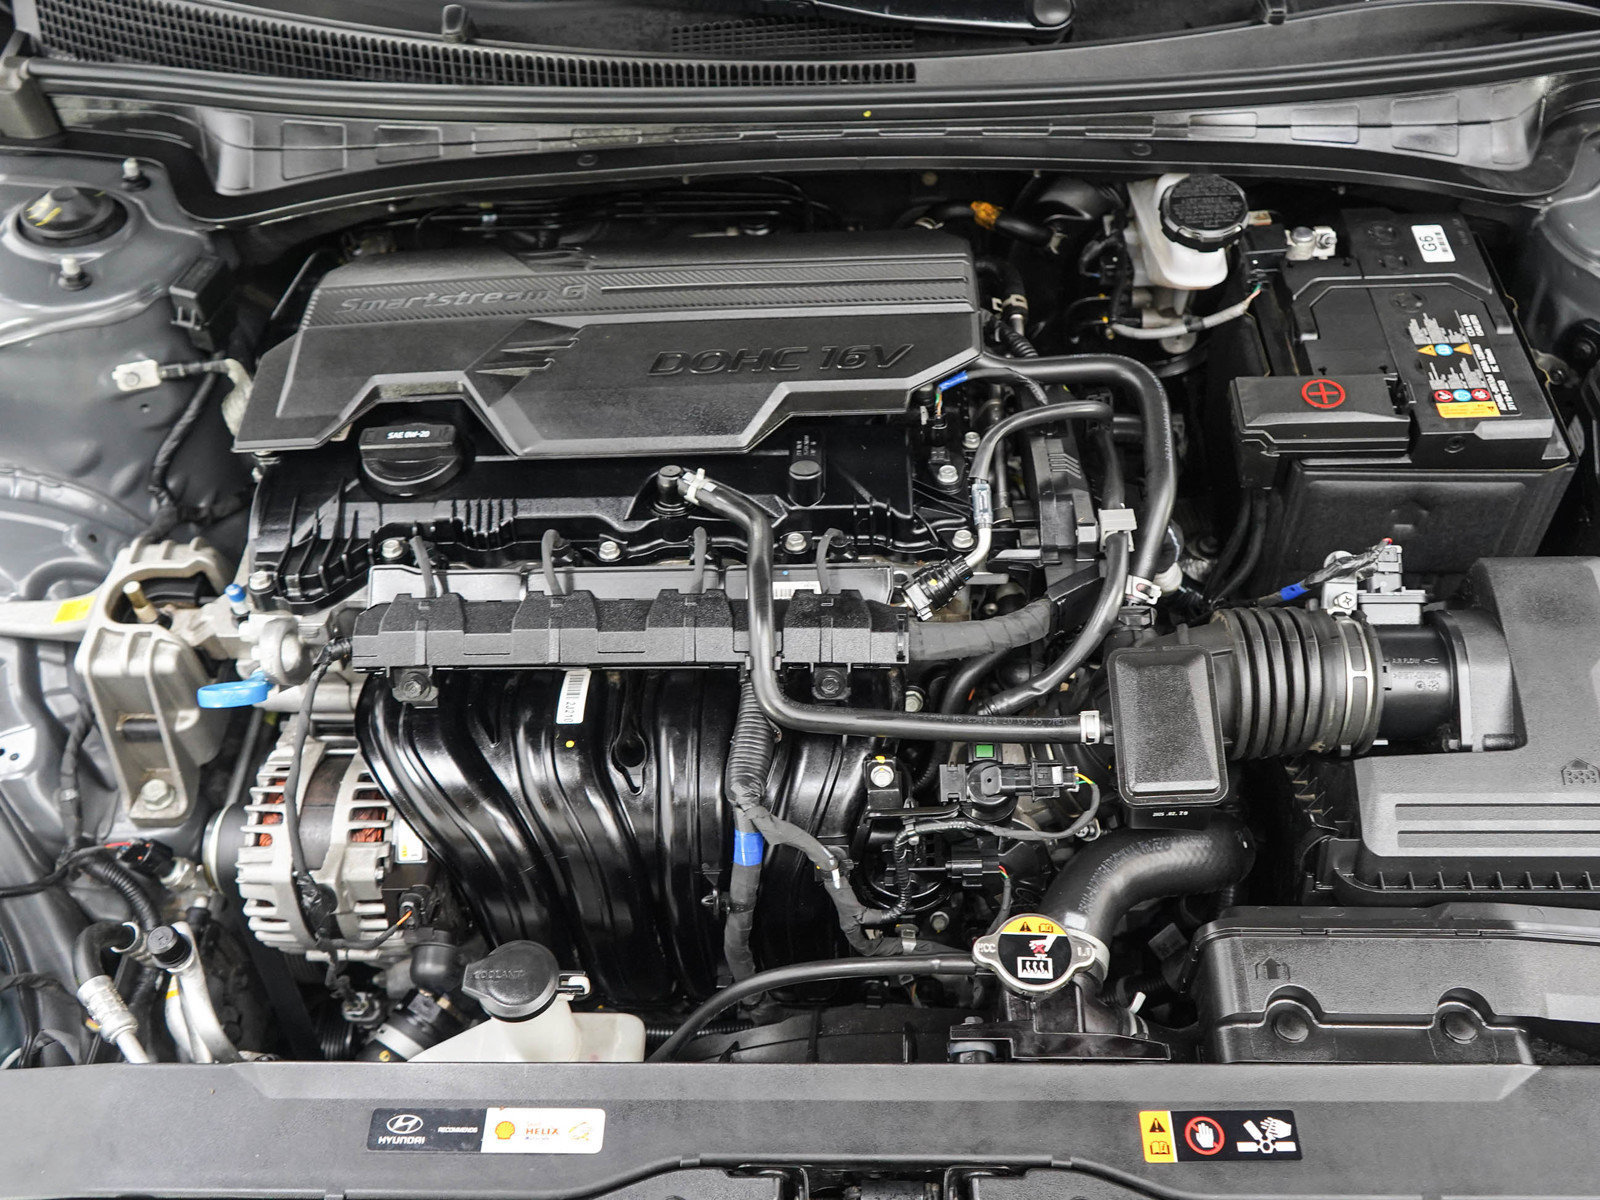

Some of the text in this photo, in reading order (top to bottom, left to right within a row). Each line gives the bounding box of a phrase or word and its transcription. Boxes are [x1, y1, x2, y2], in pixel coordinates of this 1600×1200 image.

[1418, 235, 1438, 251] G6
[334, 283, 587, 313] Smartstream G
[647, 343, 914, 375] DOHC 16V
[387, 431, 404, 439] SAE
[563, 701, 576, 722] 2J210
[473, 969, 525, 979] COOLANT
[378, 1136, 425, 1144] HYUNDAI
